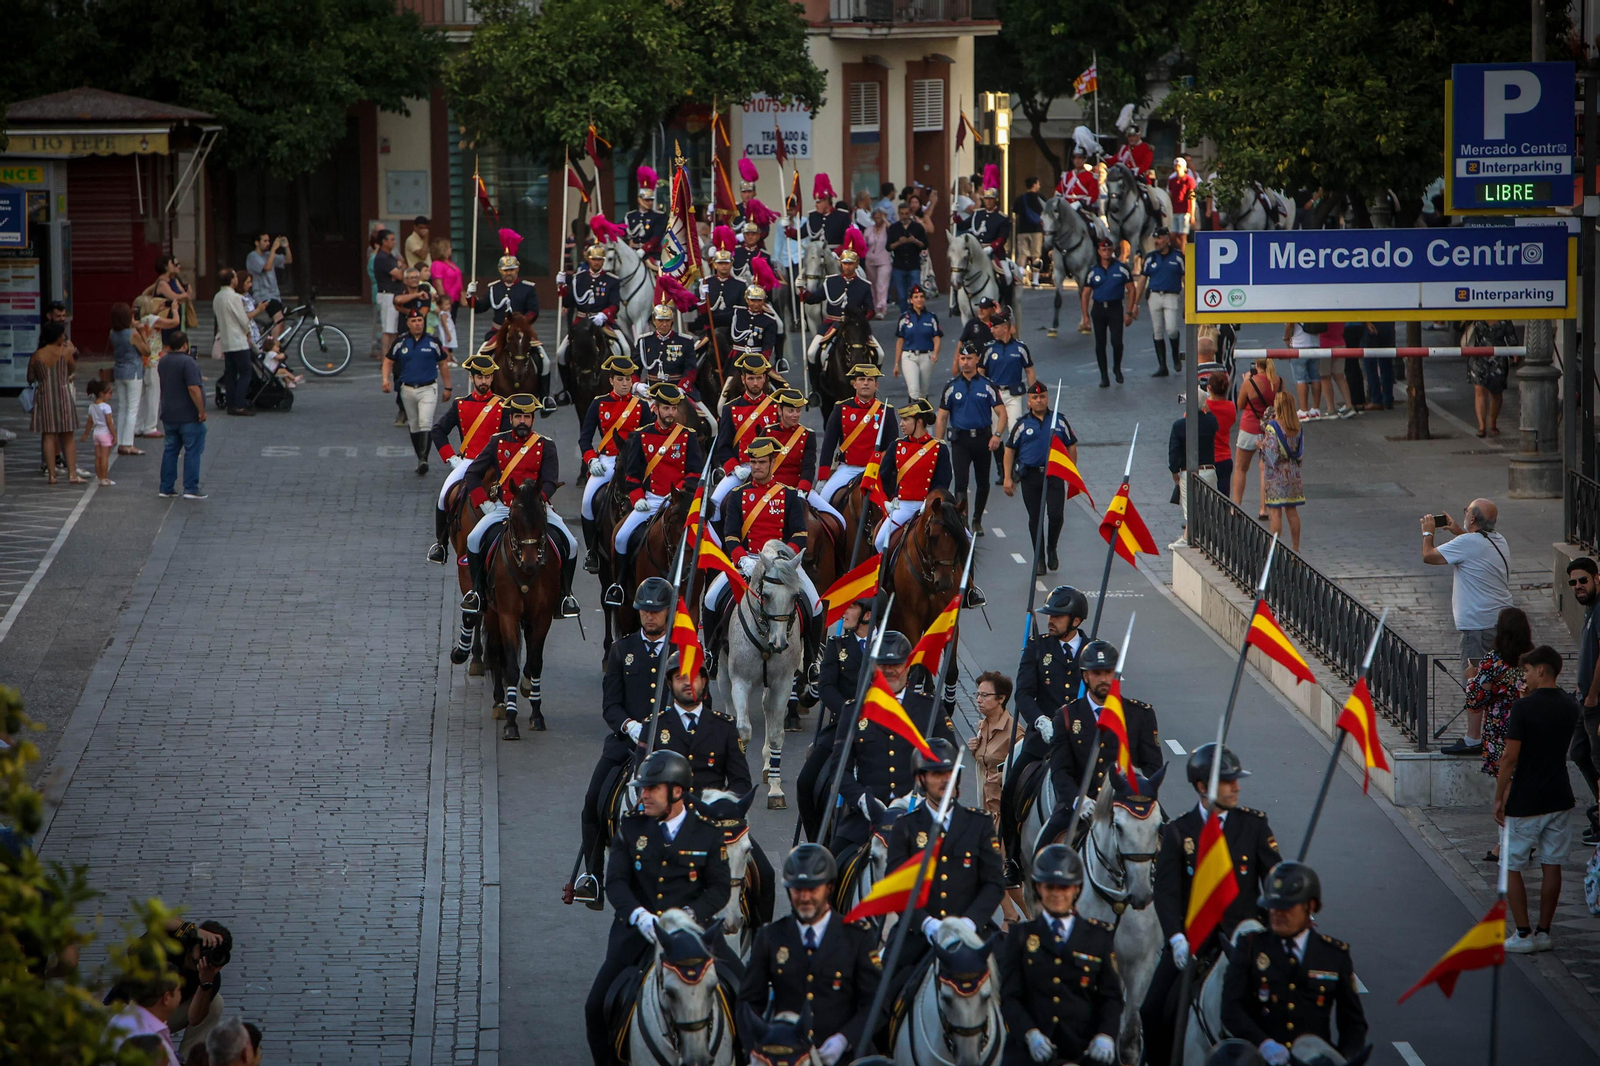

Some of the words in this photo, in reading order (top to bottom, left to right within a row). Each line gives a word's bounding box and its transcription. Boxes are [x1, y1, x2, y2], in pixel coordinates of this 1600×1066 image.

[1483, 69, 1542, 141] P
[71, 136, 116, 150] PEPE
[746, 143, 798, 155] C/LEAAS
[801, 144, 808, 155] 9
[1460, 144, 1517, 156] Mercado
[1482, 160, 1563, 174] Interparking
[1484, 183, 1535, 202] LIBRE
[1209, 238, 1239, 280] P
[1269, 241, 1414, 269] Mercado
[1472, 287, 1555, 303] Interparking
